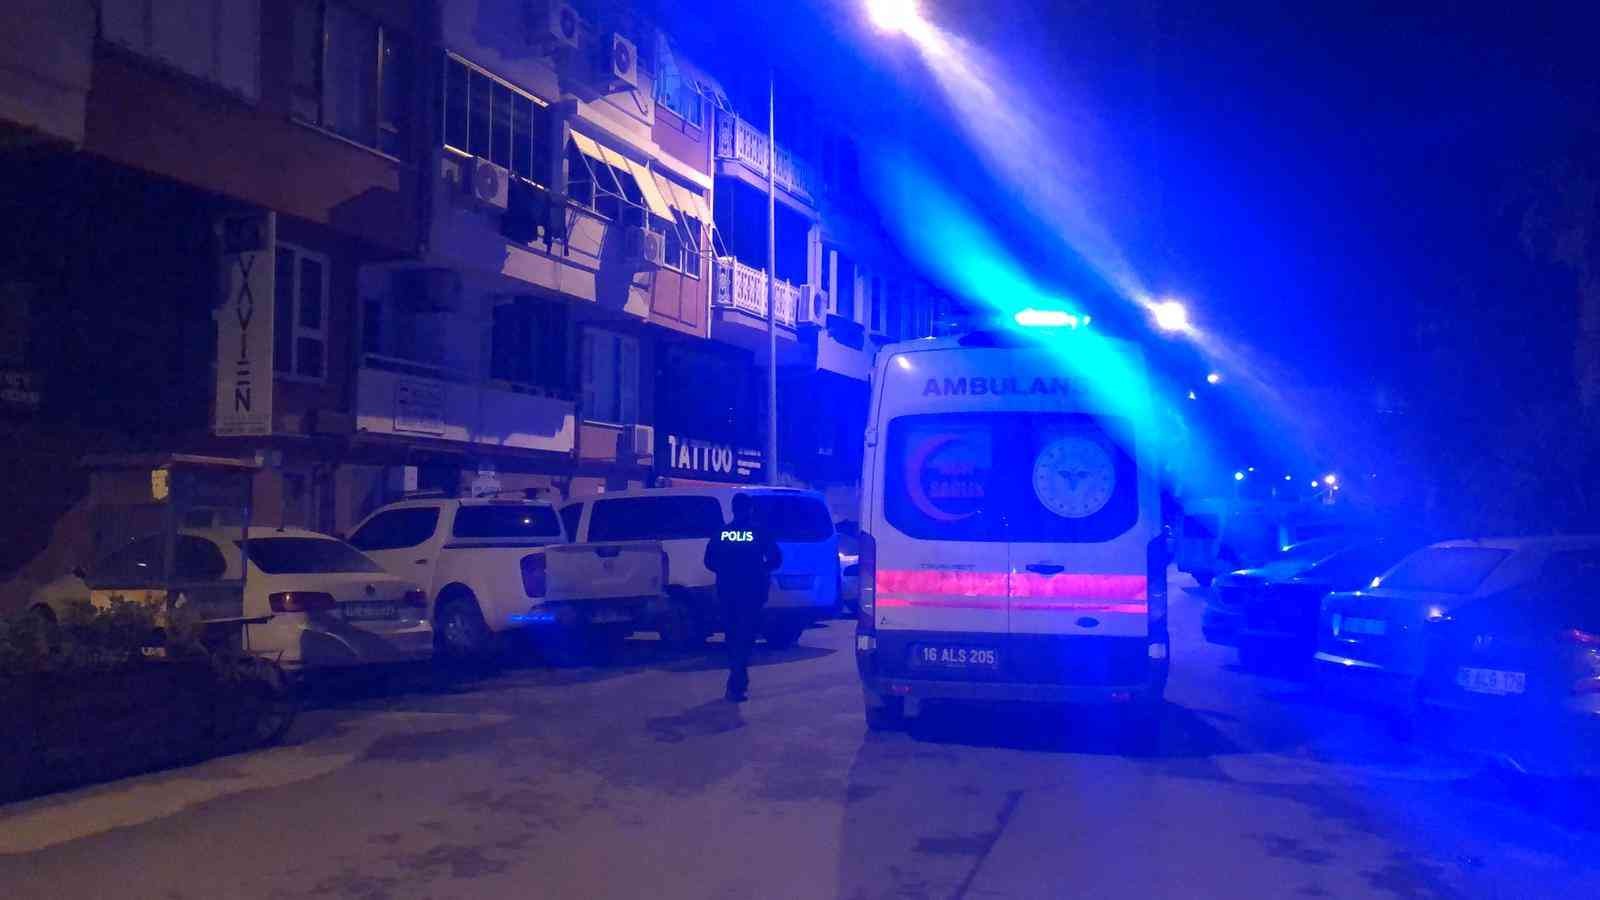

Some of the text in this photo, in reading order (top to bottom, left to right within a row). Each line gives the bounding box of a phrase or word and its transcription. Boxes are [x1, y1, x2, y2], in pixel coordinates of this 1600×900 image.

[668, 434, 733, 473] TATTOO
[923, 647, 994, 664] 16 ALS 205
